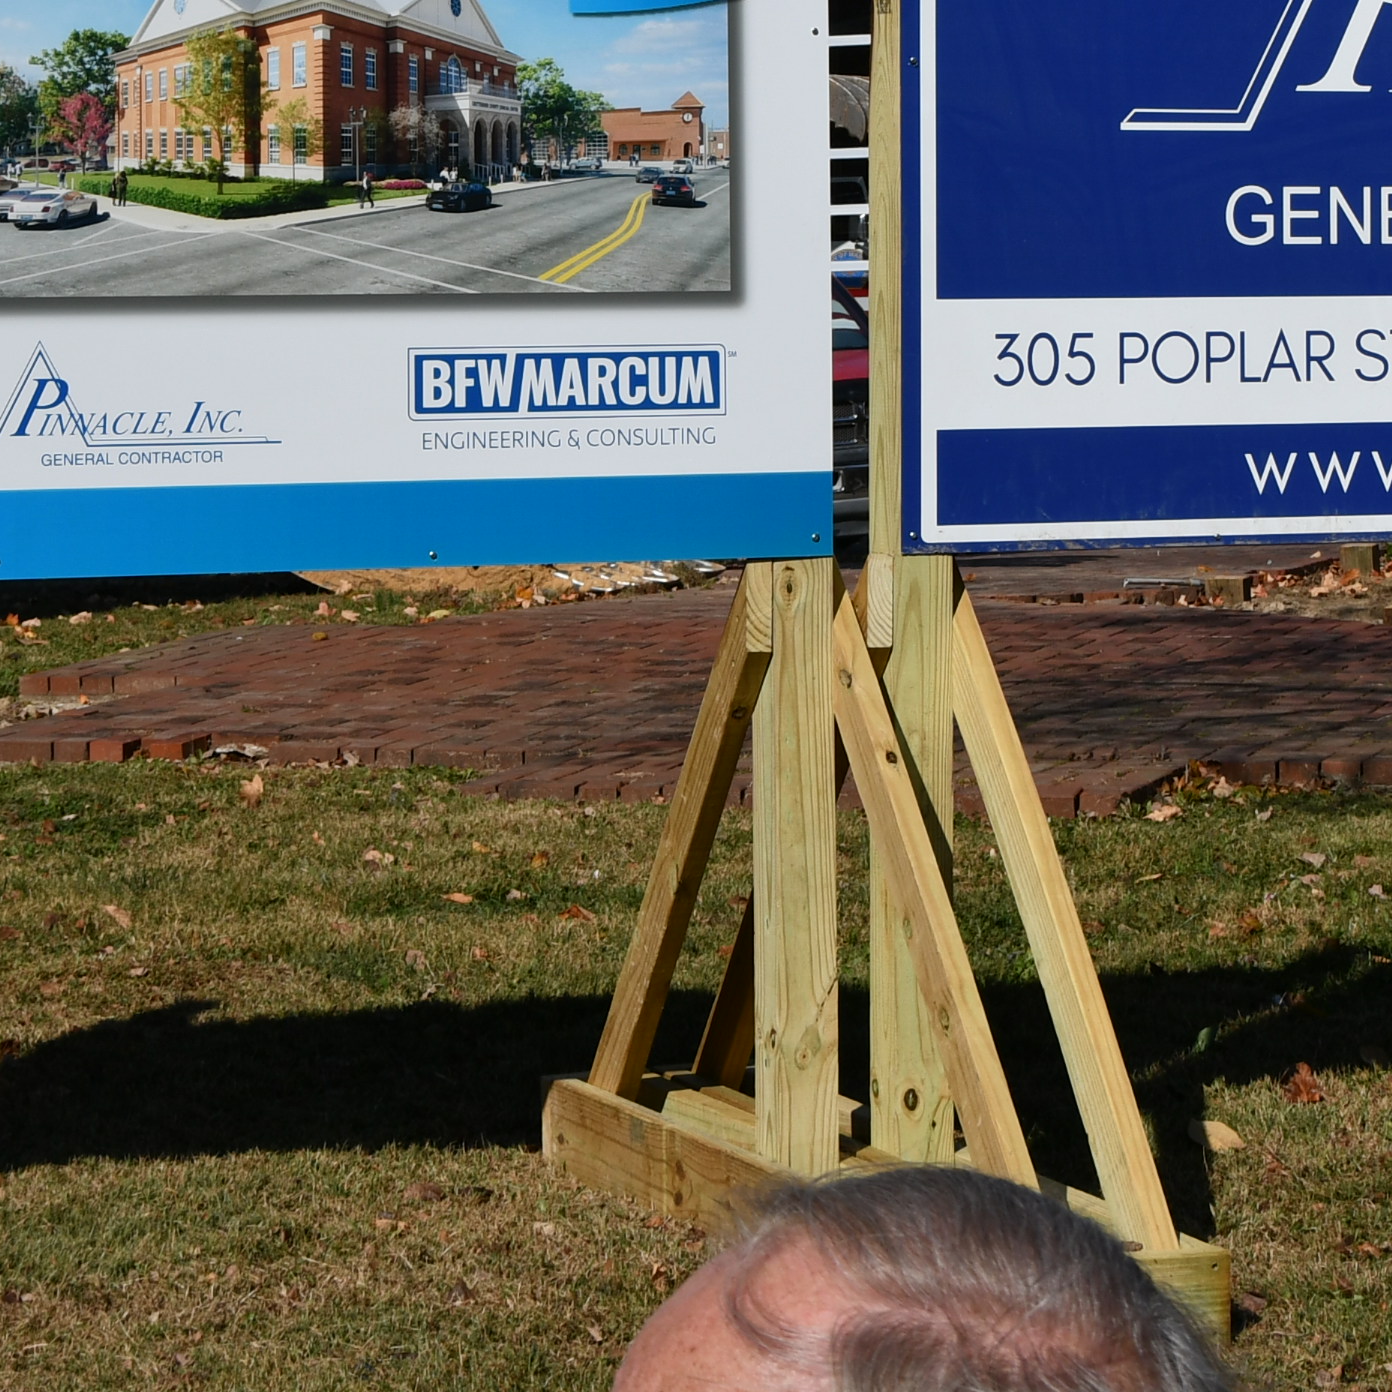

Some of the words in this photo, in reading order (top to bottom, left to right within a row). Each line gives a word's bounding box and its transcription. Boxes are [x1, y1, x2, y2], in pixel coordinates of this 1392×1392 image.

[993, 331, 1096, 387] 305
[1118, 327, 1335, 385] POPLAR
[182, 401, 244, 434] INC.
[421, 429, 561, 450] ENGINEERING
[566, 428, 581, 450] &
[585, 426, 716, 447] CONSULTING
[40, 452, 114, 467] GENERAL
[117, 449, 223, 465] CONTRACTOR
